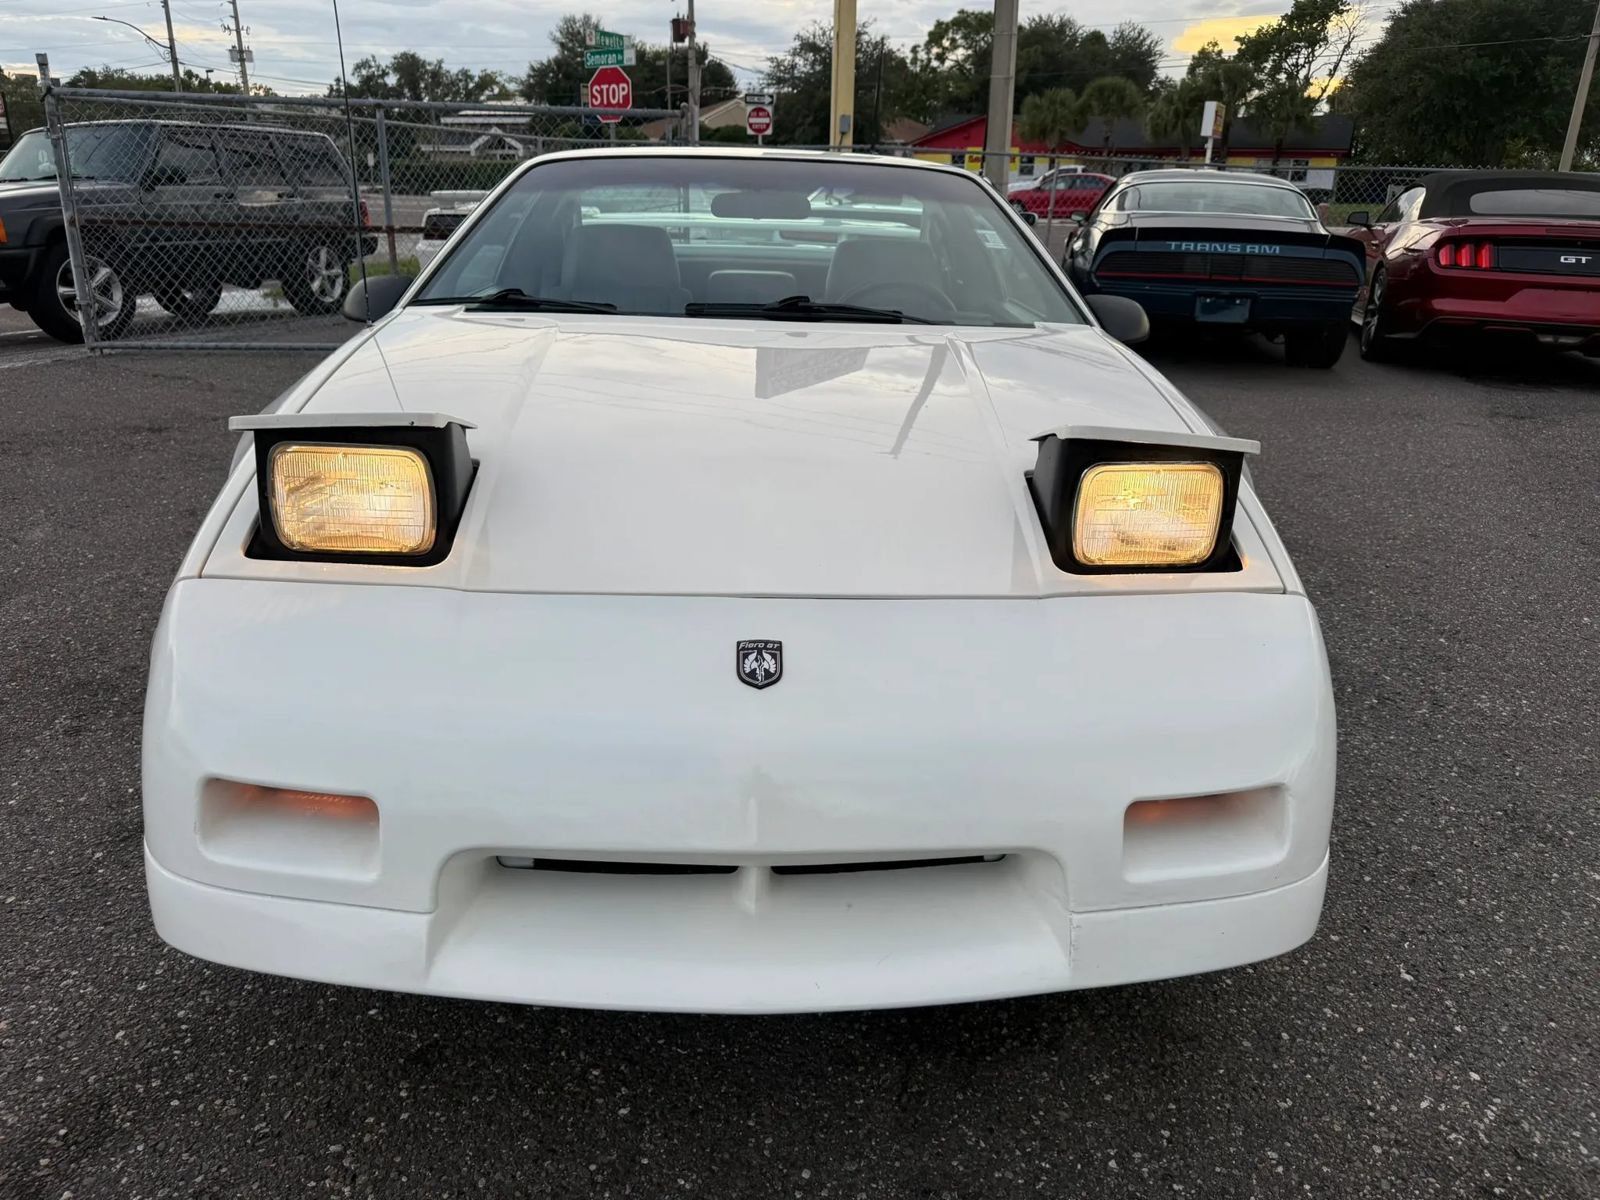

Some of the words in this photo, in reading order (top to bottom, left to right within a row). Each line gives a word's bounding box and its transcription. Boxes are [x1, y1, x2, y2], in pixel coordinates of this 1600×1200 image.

[586, 52, 617, 66] Semoran
[592, 82, 629, 105] STOP
[1166, 241, 1241, 253] TRANS
[1246, 244, 1280, 254] AM
[1560, 255, 1593, 264] GT
